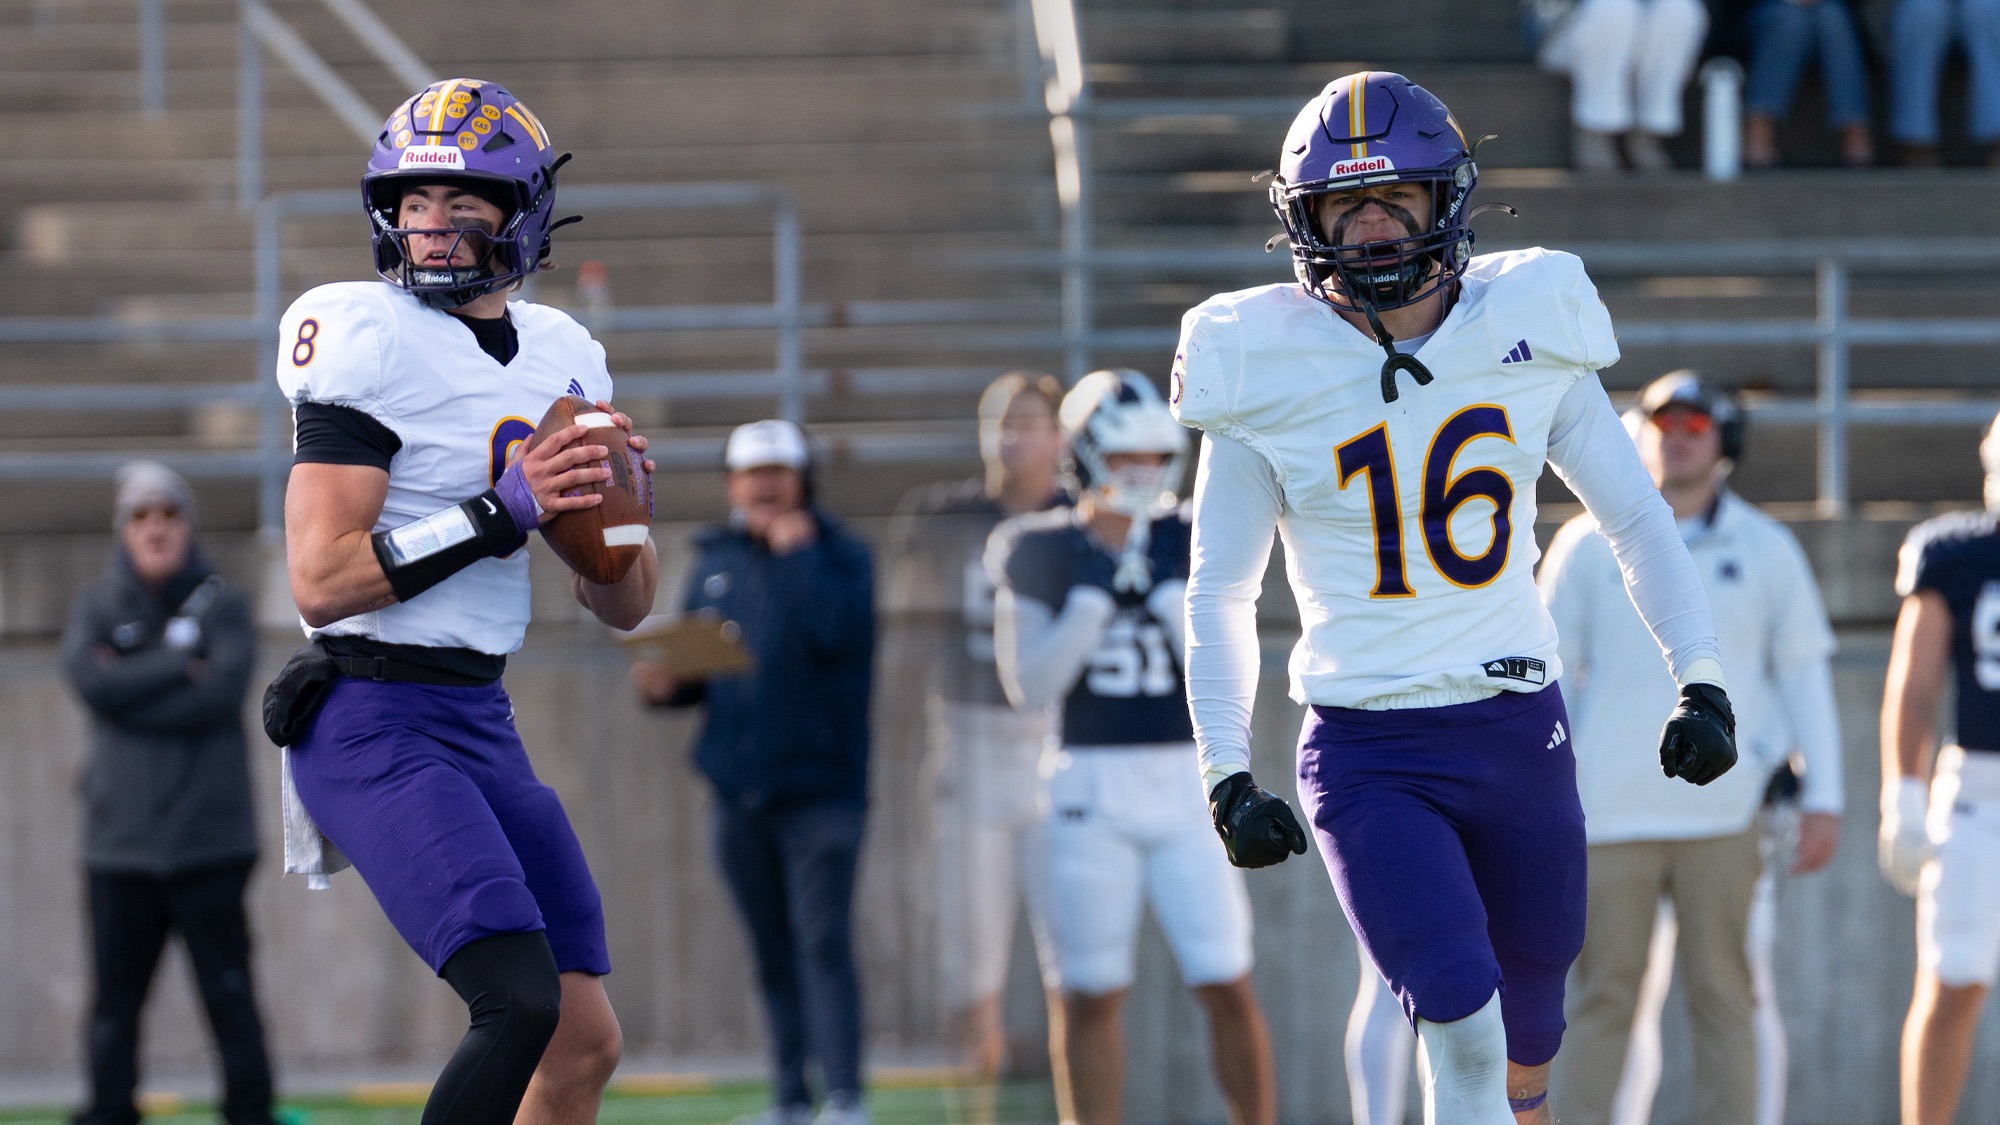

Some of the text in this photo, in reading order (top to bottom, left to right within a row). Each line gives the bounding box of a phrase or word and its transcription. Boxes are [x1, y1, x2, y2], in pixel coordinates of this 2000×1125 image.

[474, 121, 489, 130] GAS
[405, 152, 457, 163] Riddell
[1335, 159, 1386, 175] Riddell
[1437, 191, 1465, 229] Rddell
[424, 274, 454, 283] Riddel
[292, 317, 321, 369] 8
[1333, 403, 1516, 599] 16
[1516, 664, 1521, 674] L
